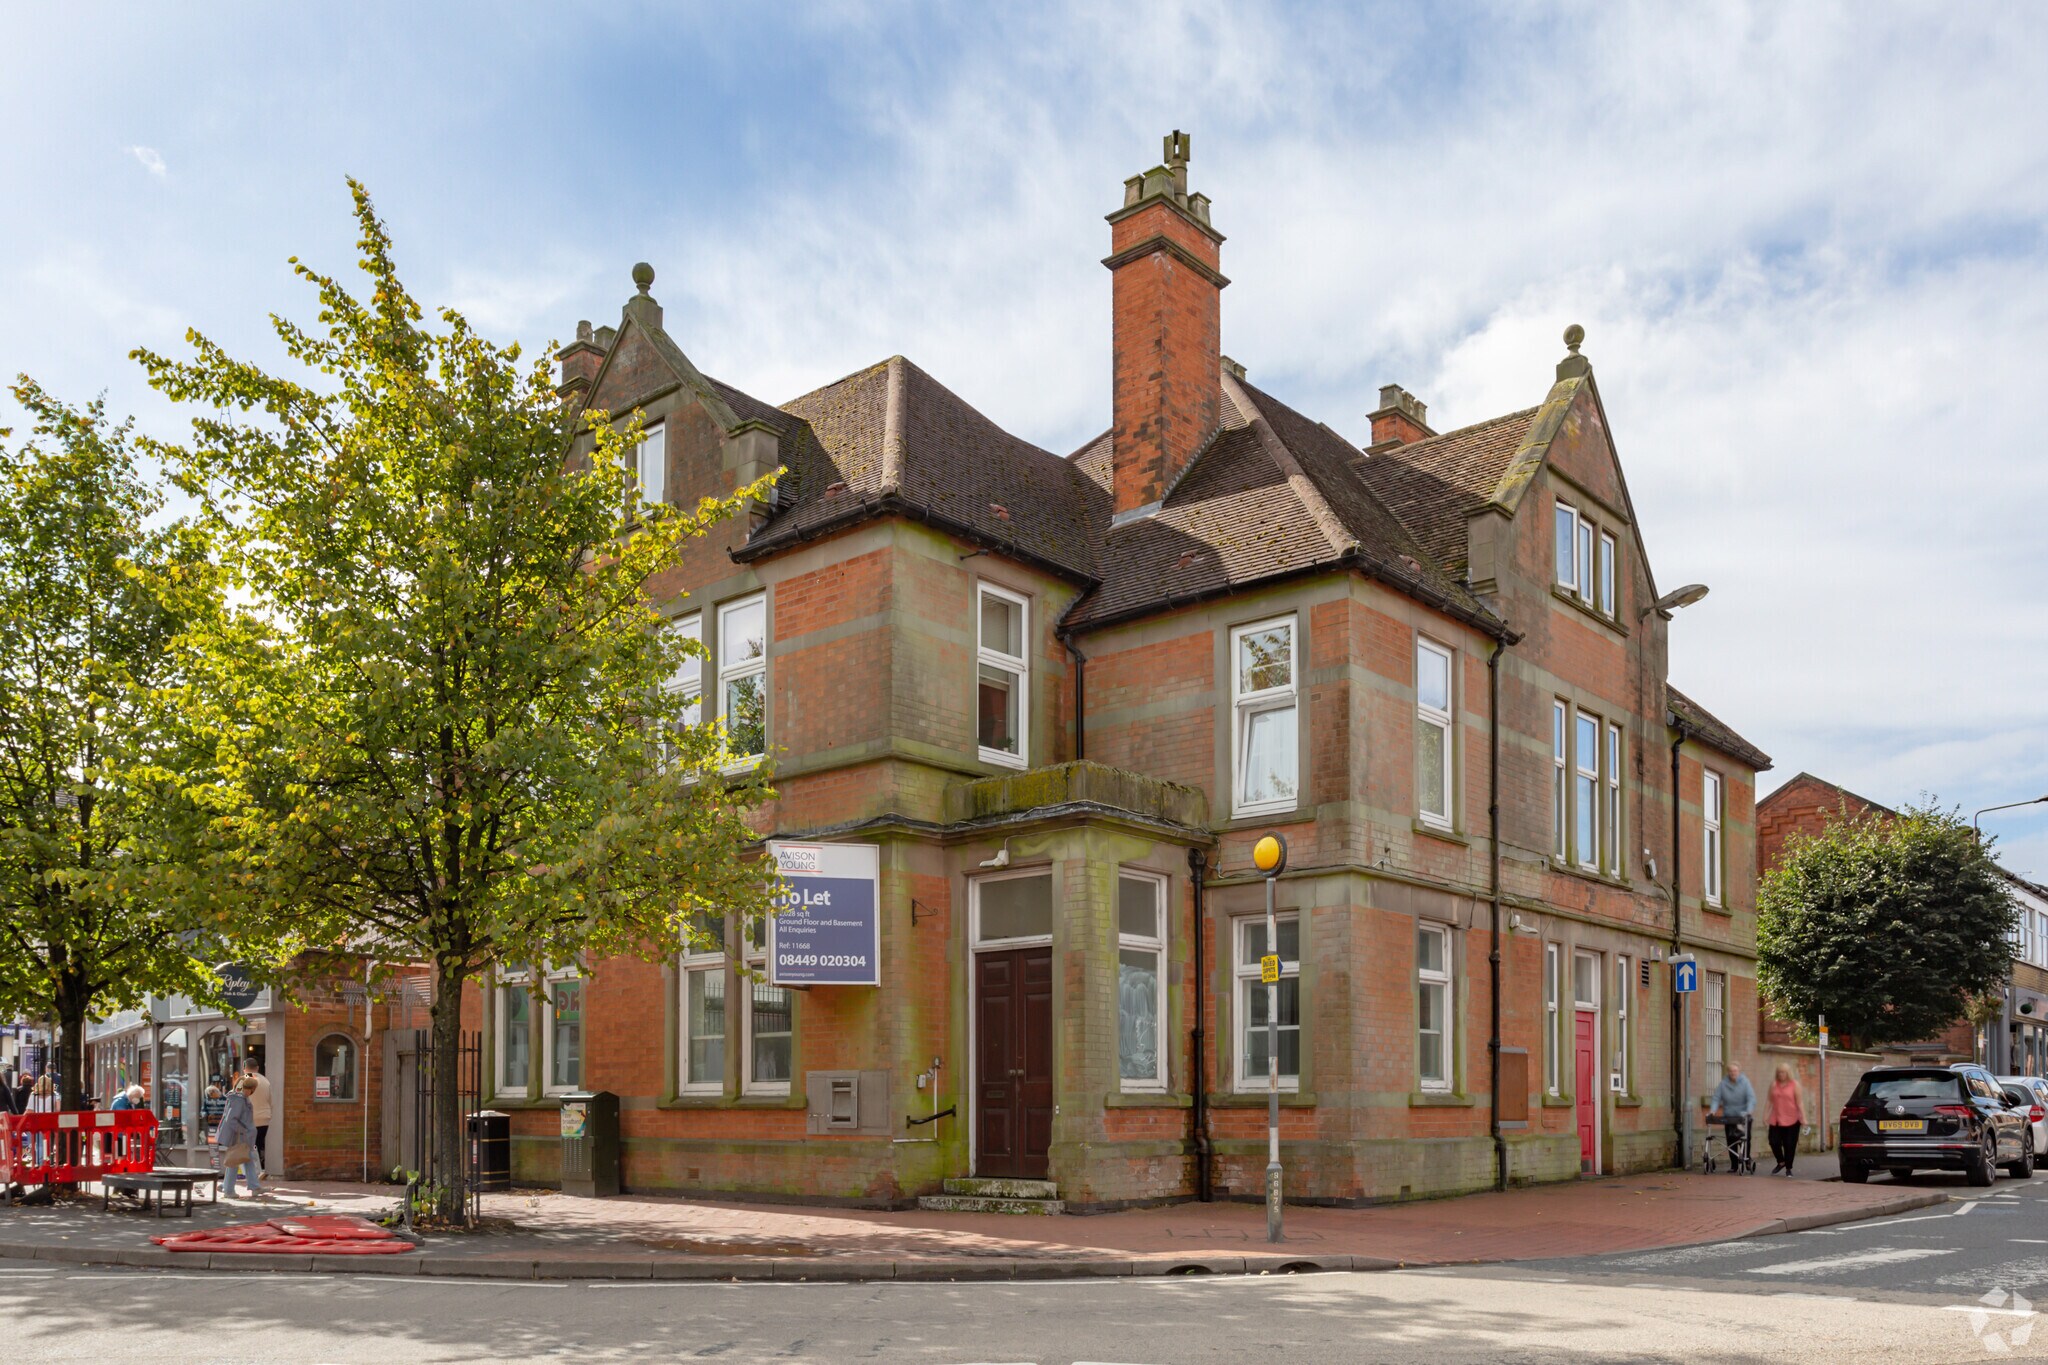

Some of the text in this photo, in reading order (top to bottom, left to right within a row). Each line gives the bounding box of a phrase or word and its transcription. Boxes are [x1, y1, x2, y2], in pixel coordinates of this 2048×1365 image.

[780, 851, 815, 861] AVISON
[780, 860, 815, 870] YOUNG
[780, 888, 831, 906] To Let
[803, 918, 820, 926] Floor
[833, 919, 863, 927] Basement
[788, 926, 817, 934] Enquiries
[779, 954, 866, 967] 08449 020304
